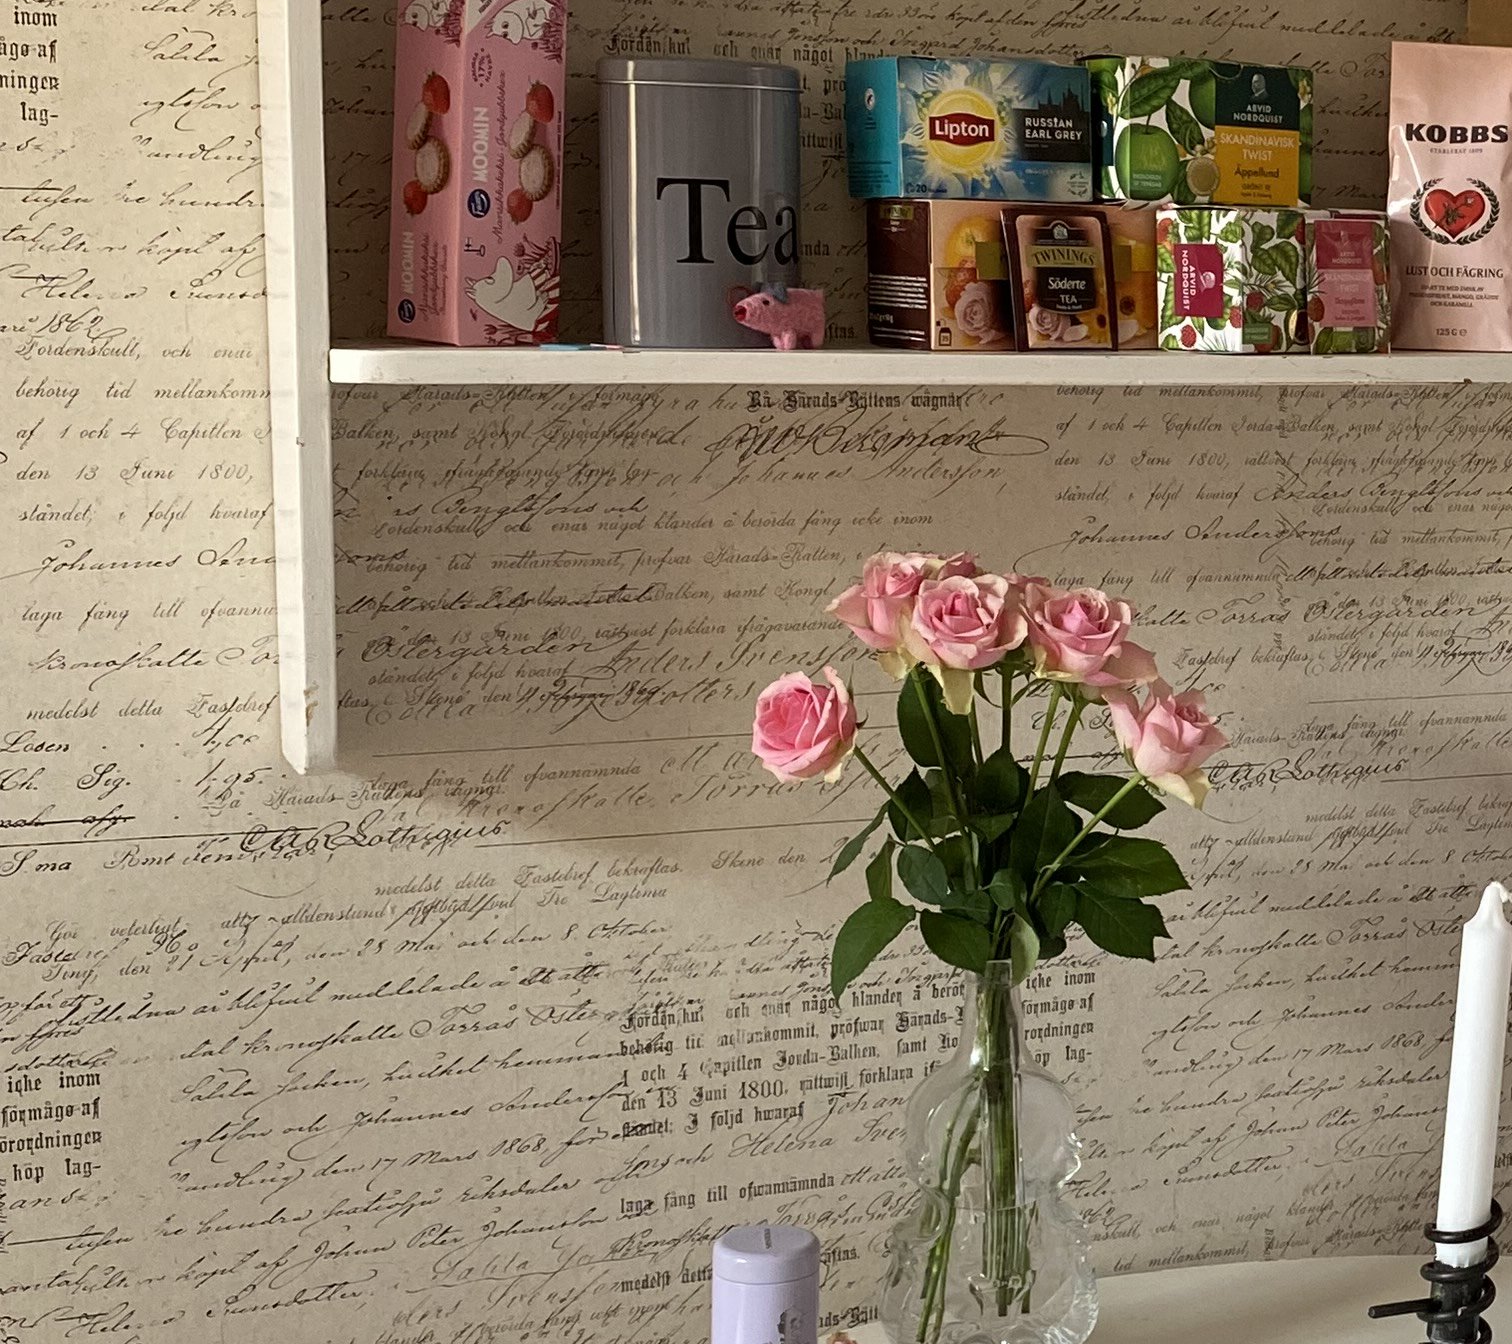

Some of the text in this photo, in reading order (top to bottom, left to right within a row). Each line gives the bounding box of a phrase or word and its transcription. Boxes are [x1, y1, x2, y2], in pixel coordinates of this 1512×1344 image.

[935, 119, 990, 140] Lipton
[1025, 116, 1073, 129] RUSSIAN
[1025, 129, 1083, 141] EARL GREY
[1219, 133, 1294, 148] SKANDINAVISK
[1405, 123, 1509, 144] KOBBS
[472, 106, 490, 182] MOOMIN
[1242, 149, 1273, 161] TWIST
[915, 184, 928, 194] 20
[657, 177, 798, 265] Tea
[1032, 248, 1095, 265] TWININGS
[1406, 265, 1504, 278] LUST OCH FÄGRING
[1047, 277, 1087, 290] Söderte
[1182, 250, 1190, 310] NORDQUIST
[1189, 265, 1197, 296] ARVID
[1059, 294, 1078, 304] TEA
[1436, 328, 1450, 336] 125
[706, 1185, 728, 1203] till
